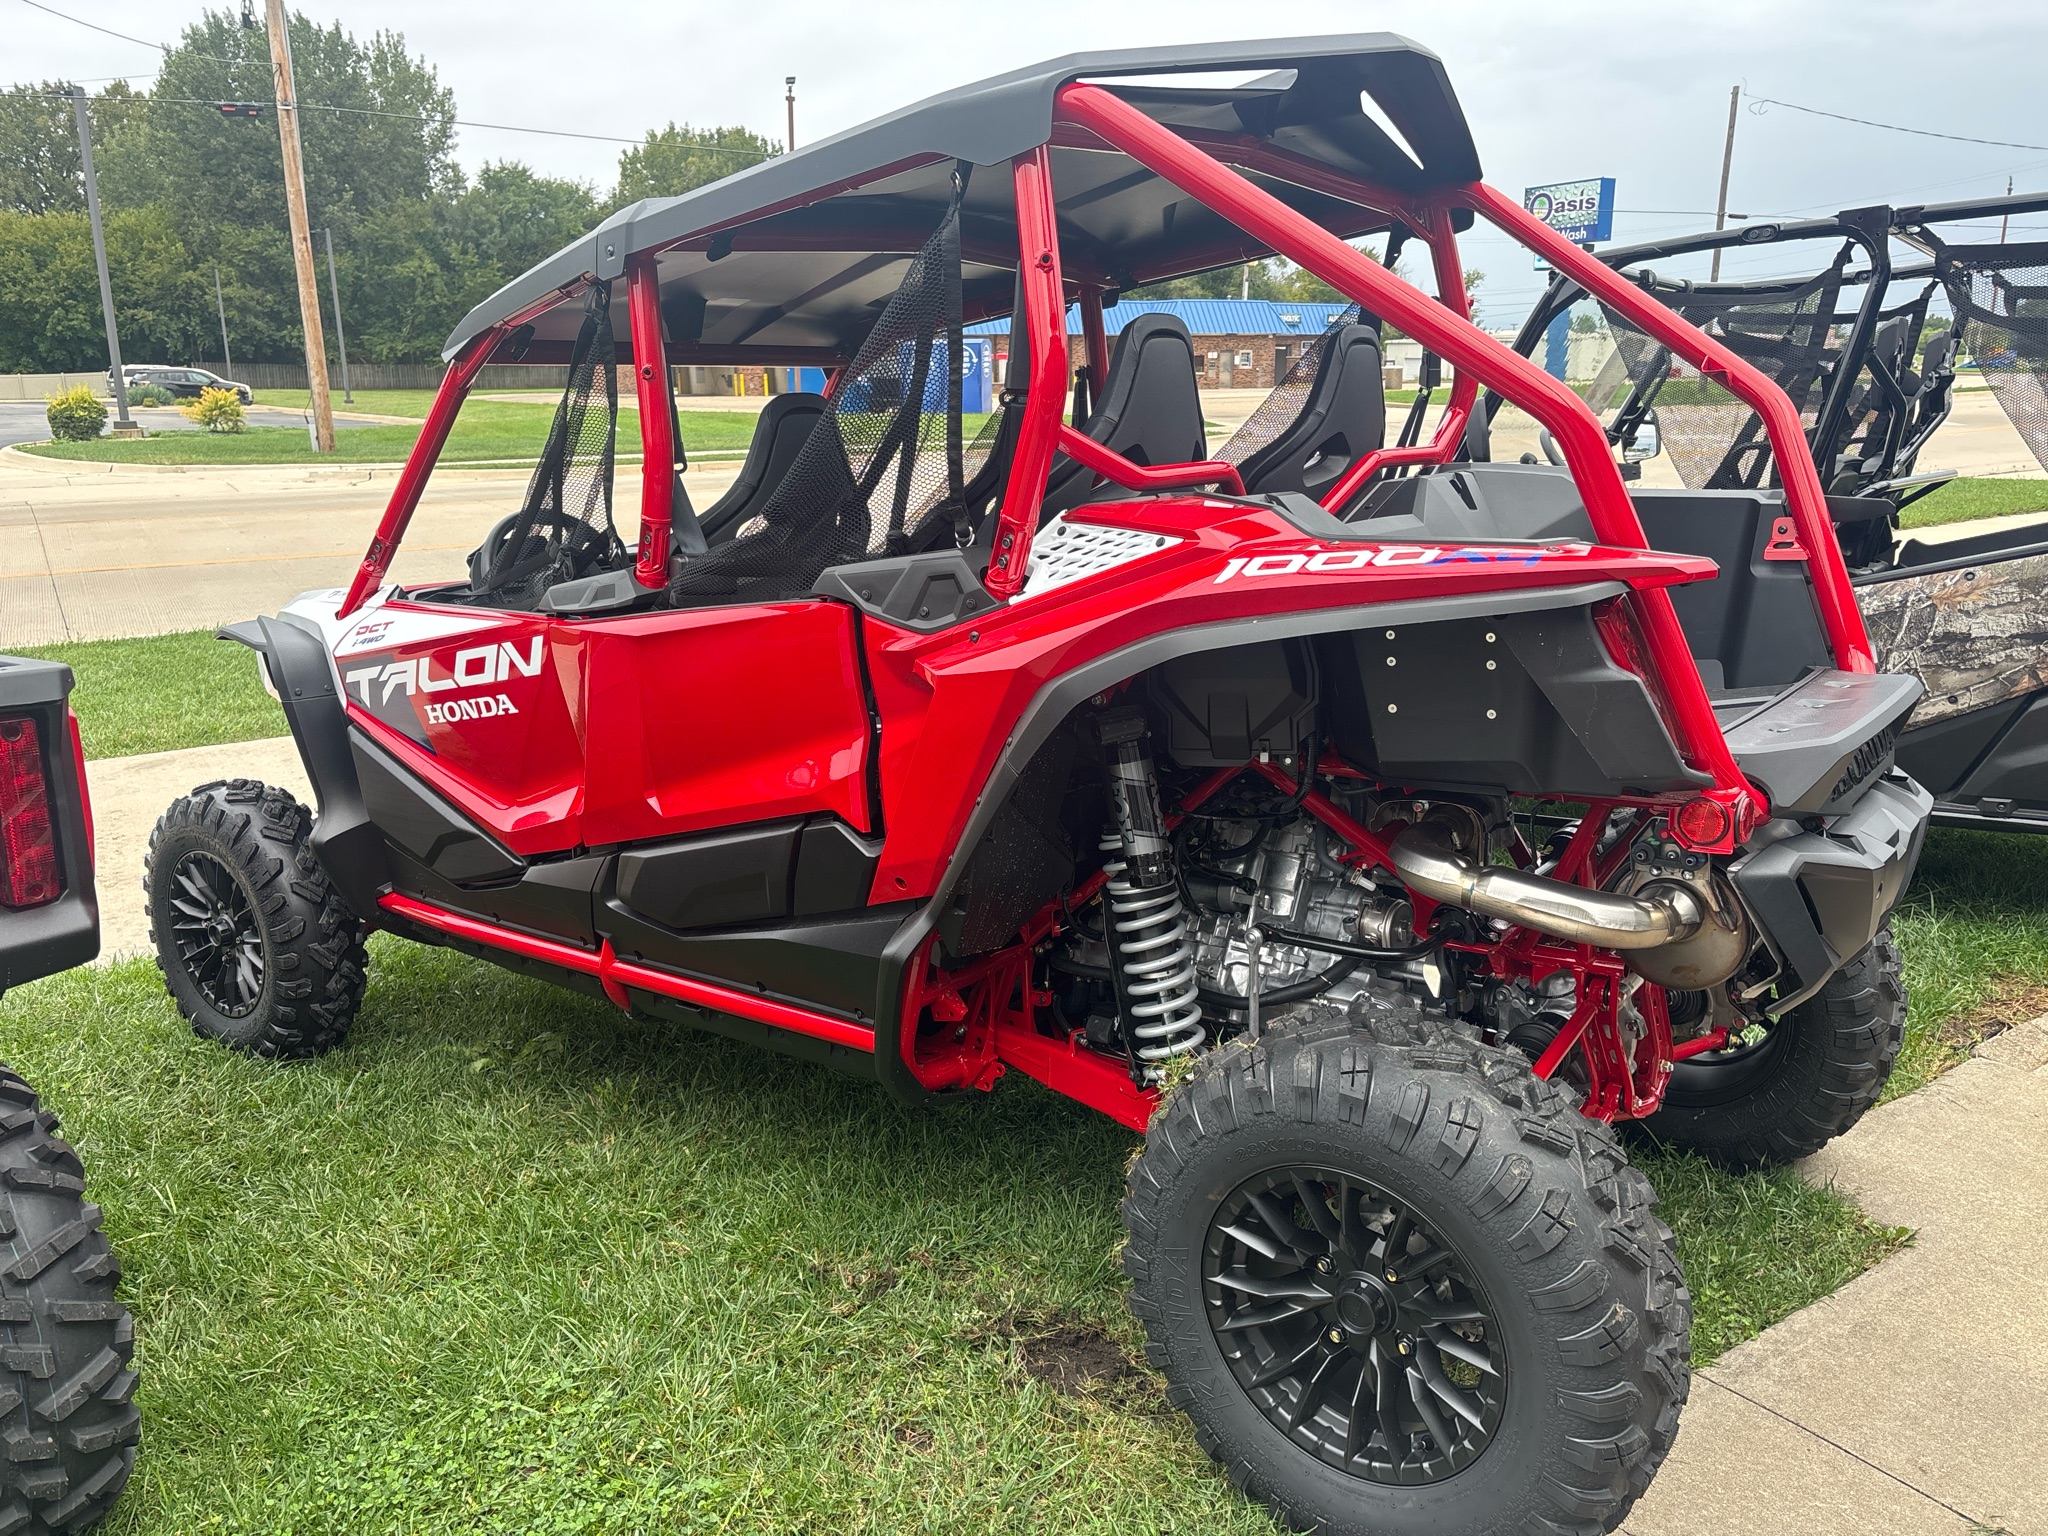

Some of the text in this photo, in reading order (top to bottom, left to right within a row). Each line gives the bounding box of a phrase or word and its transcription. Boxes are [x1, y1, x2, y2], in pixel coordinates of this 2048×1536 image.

[1529, 188, 1596, 222] Oasis
[355, 621, 395, 636] DCT
[345, 635, 543, 709] TALON
[423, 694, 519, 725] HONDA
[1164, 1247, 1235, 1410] KENDA
